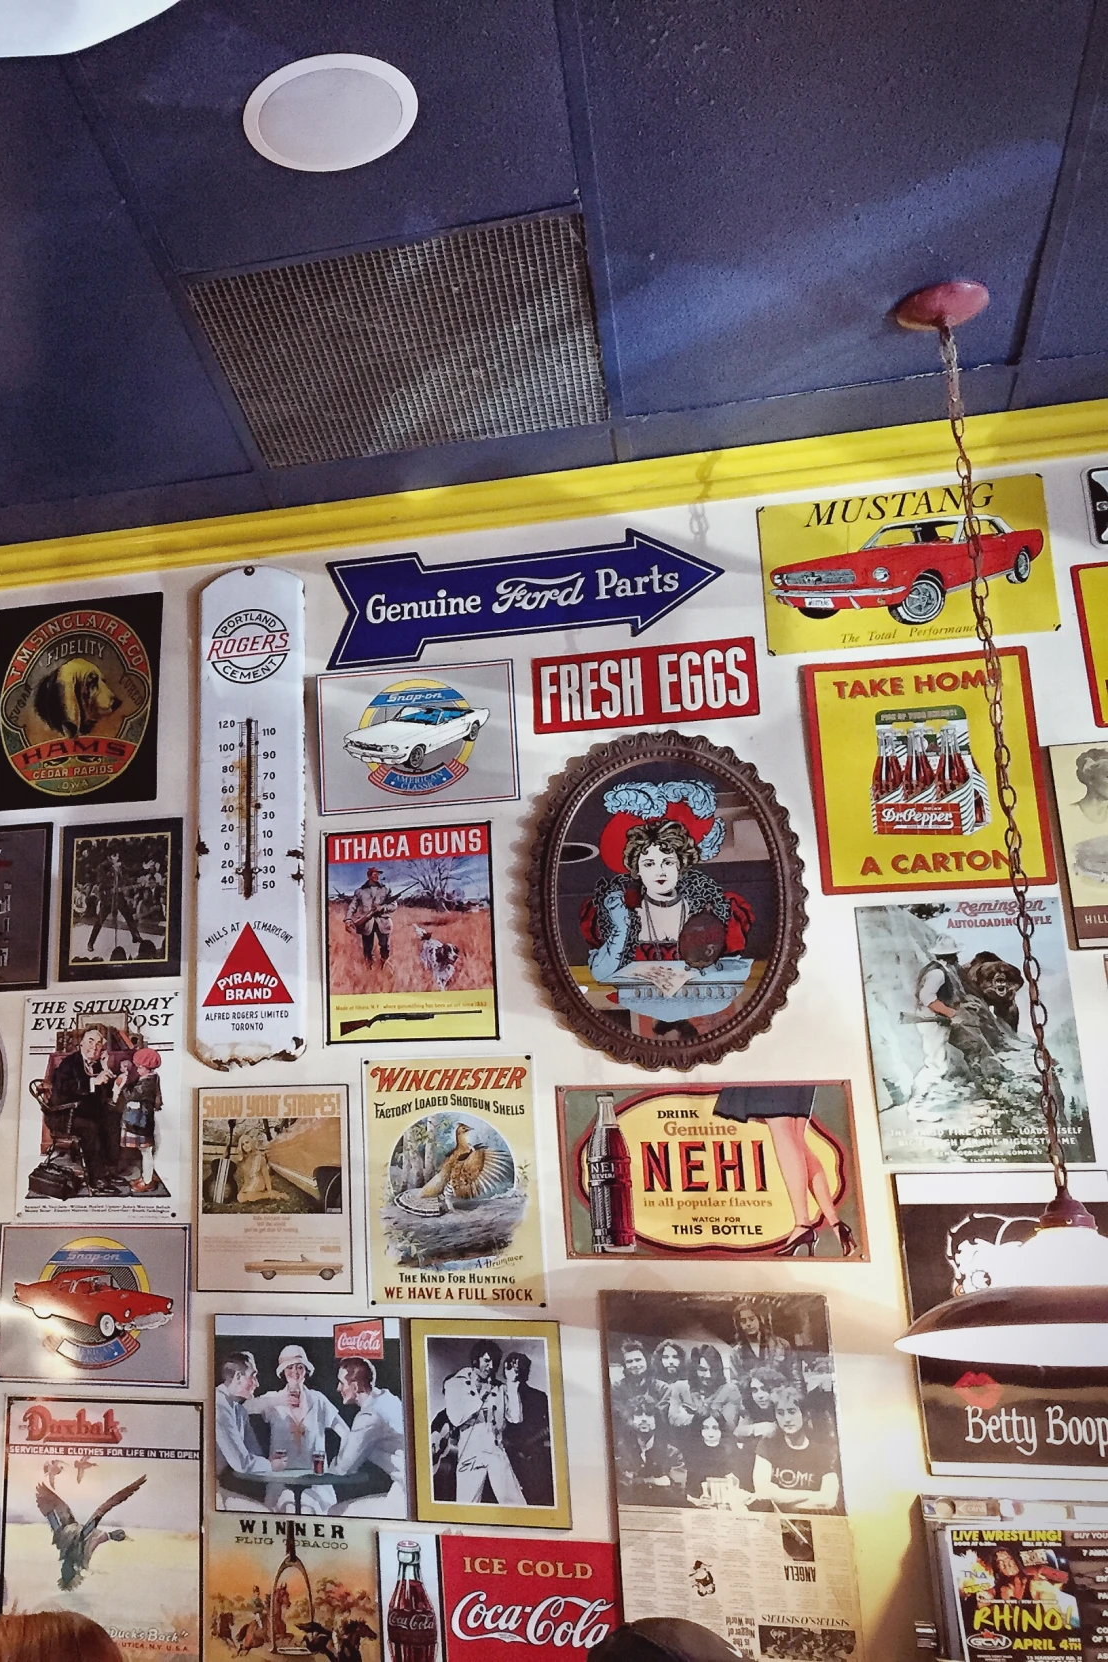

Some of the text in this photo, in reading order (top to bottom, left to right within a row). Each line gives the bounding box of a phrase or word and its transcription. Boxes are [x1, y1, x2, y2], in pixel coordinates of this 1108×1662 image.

[804, 482, 994, 528] MUSTANG
[365, 564, 680, 625] Genuine Ford Parts
[221, 612, 277, 635] PORTLAND
[34, 614, 144, 667] SINCLAIR & CO
[207, 632, 290, 661] ROGERS
[841, 629, 897, 644] The Total
[45, 638, 105, 667] FIDELITY
[222, 659, 277, 680] CEMENT
[540, 645, 750, 725] FRESH EGGS
[833, 676, 905, 700] TAKE
[9, 683, 34, 724] SUGAR
[218, 720, 236, 729] 120
[262, 727, 276, 736] 110
[22, 740, 126, 765] HAMS
[218, 743, 236, 752] 100
[262, 751, 276, 760] 90
[33, 764, 114, 779] CEDAR RAPIDS
[221, 765, 235, 774] 80
[394, 771, 443, 783] AMERICAN
[333, 828, 483, 860] ITHACA GUNS
[860, 856, 883, 876] A
[204, 926, 229, 947] MILLS
[216, 971, 279, 991] PYRAMID
[225, 987, 272, 1001] BRAND
[31, 996, 175, 1017] THE SATURDAY
[205, 1010, 289, 1021] ALFRED ROGERS LIMITED
[231, 1022, 264, 1031] TORONTO
[370, 1066, 527, 1093] WINCHESTER
[373, 1093, 525, 1119] FACTORY LOADED SHOTGUN SHELLS
[663, 1121, 738, 1137] Genuine
[640, 1140, 769, 1192] NEHI
[643, 1197, 773, 1211] in all popular flavors
[672, 1225, 764, 1236] THIS BOTTLE
[398, 1272, 516, 1284] THE KIND FOR HUNTING
[384, 1286, 533, 1301] WE HAVE A FULL STOCK
[21, 1405, 123, 1444] Duxbak
[965, 1404, 1037, 1456] Betty
[9, 1445, 200, 1459] SERVICEABLE CLOTHES FOR LIFE IN THE OPEN
[239, 1519, 345, 1539] WINNER
[953, 1530, 1063, 1542] LIVE WRESTLING!
[234, 1536, 274, 1545] PLUG
[463, 1556, 593, 1579] ICE COLD
[783, 1565, 817, 1583] ANGELA
[451, 1590, 614, 1649] Coca-Cola
[973, 1603, 1073, 1633] RHINO!
[109, 1626, 146, 1640] Duck's
[1013, 1638, 1057, 1650] APRIL
